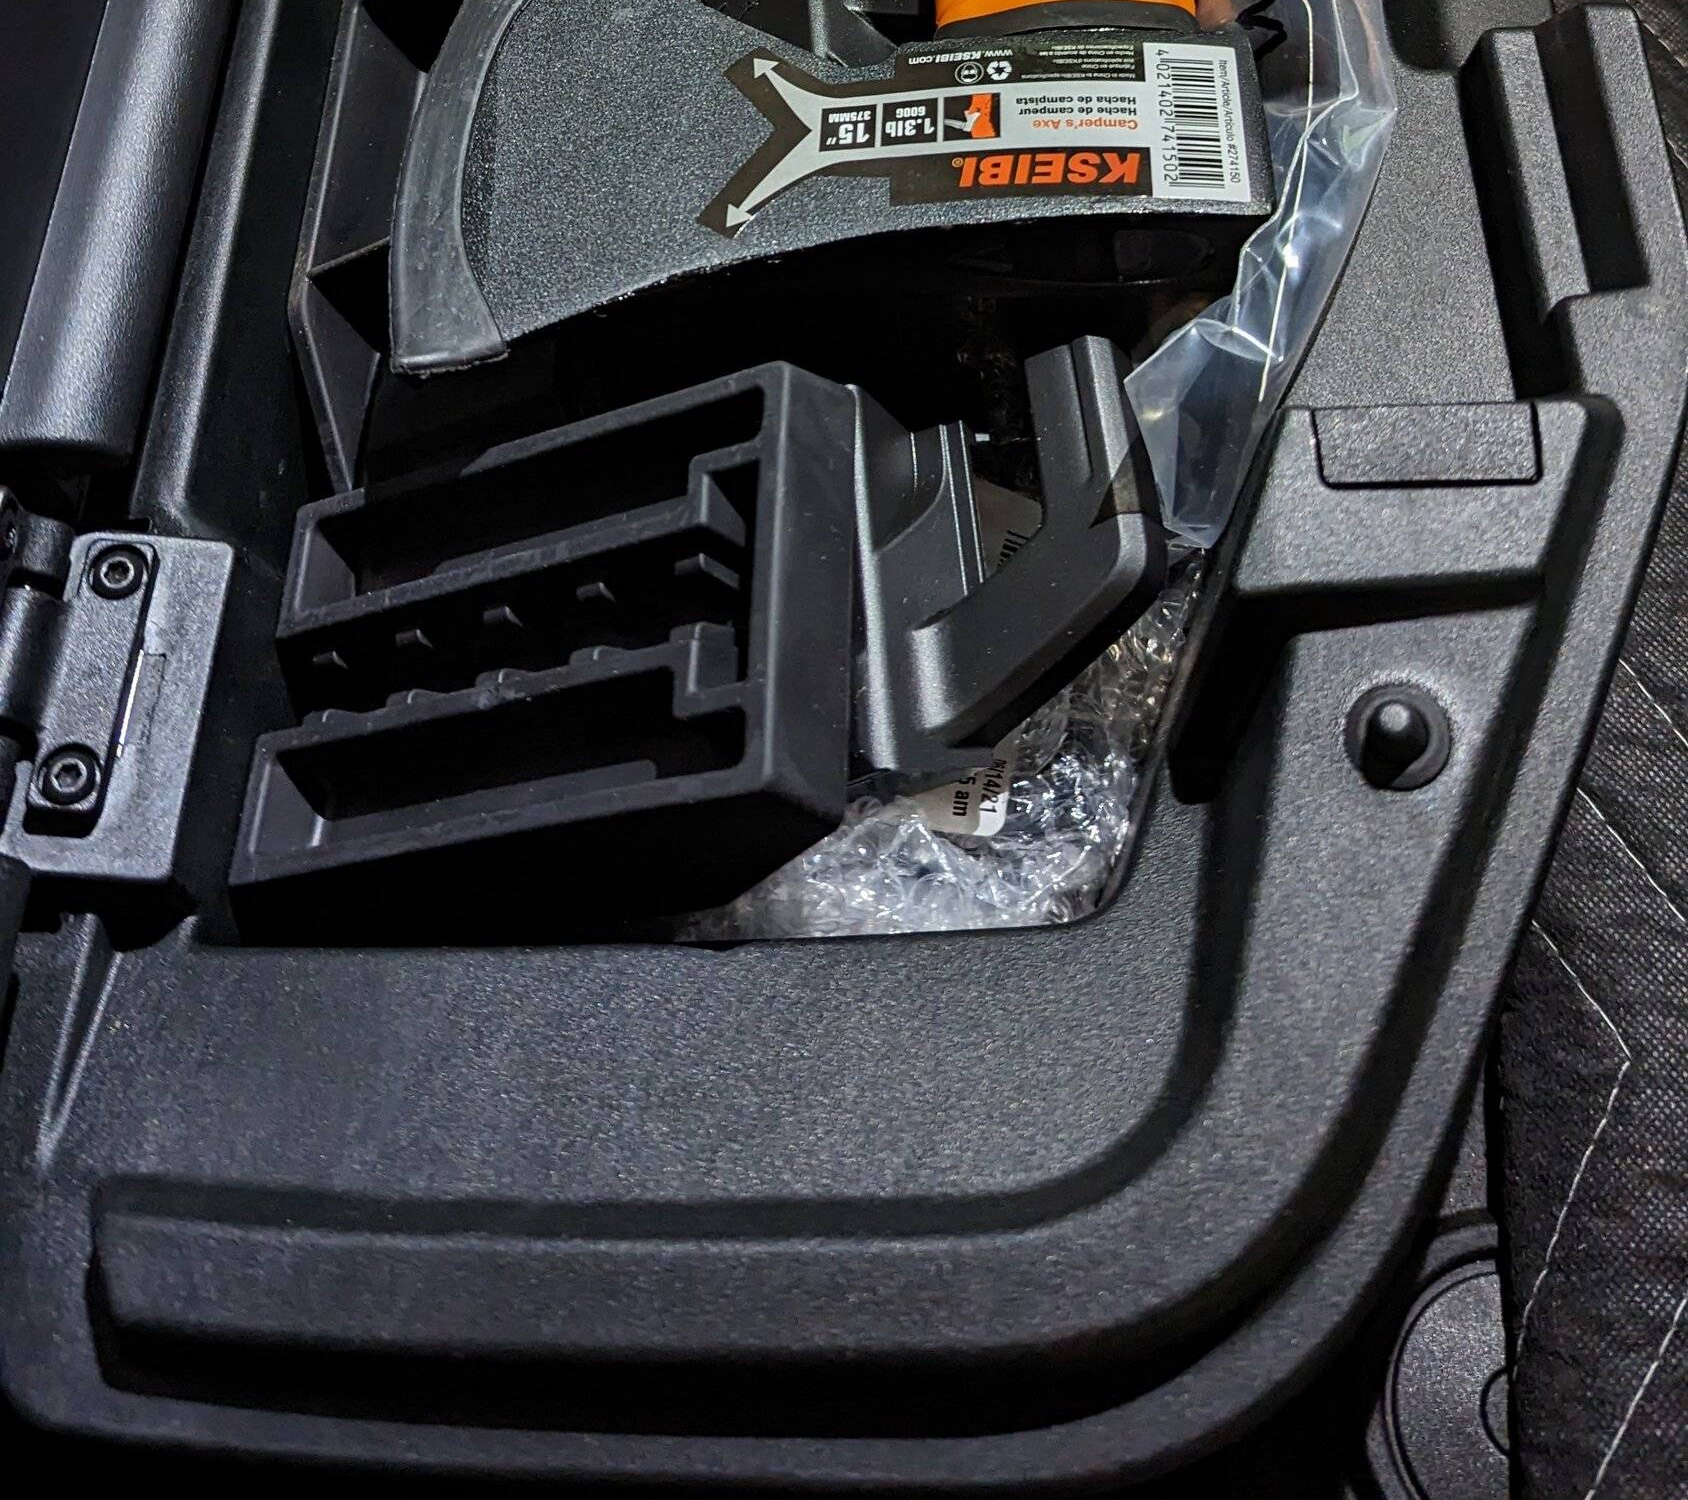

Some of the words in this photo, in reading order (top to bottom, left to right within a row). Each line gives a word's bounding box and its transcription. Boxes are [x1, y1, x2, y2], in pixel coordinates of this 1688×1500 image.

[908, 49, 1013, 65] www.KSEIBI.com
[1156, 63, 1173, 117] 021402
[1016, 95, 1074, 105] campista
[1077, 96, 1092, 105] de
[1096, 96, 1136, 105] Hacha
[828, 110, 871, 123] 375MM
[1018, 106, 1074, 116] campeur
[1078, 107, 1093, 116] de
[1097, 107, 1137, 116] Hache
[885, 117, 935, 138] 1.3lb
[1033, 119, 1061, 130] Axe
[1065, 117, 1138, 130] Camper's
[1160, 125, 1178, 182] 741502
[1227, 143, 1241, 183] #274150
[952, 790, 970, 817] am
